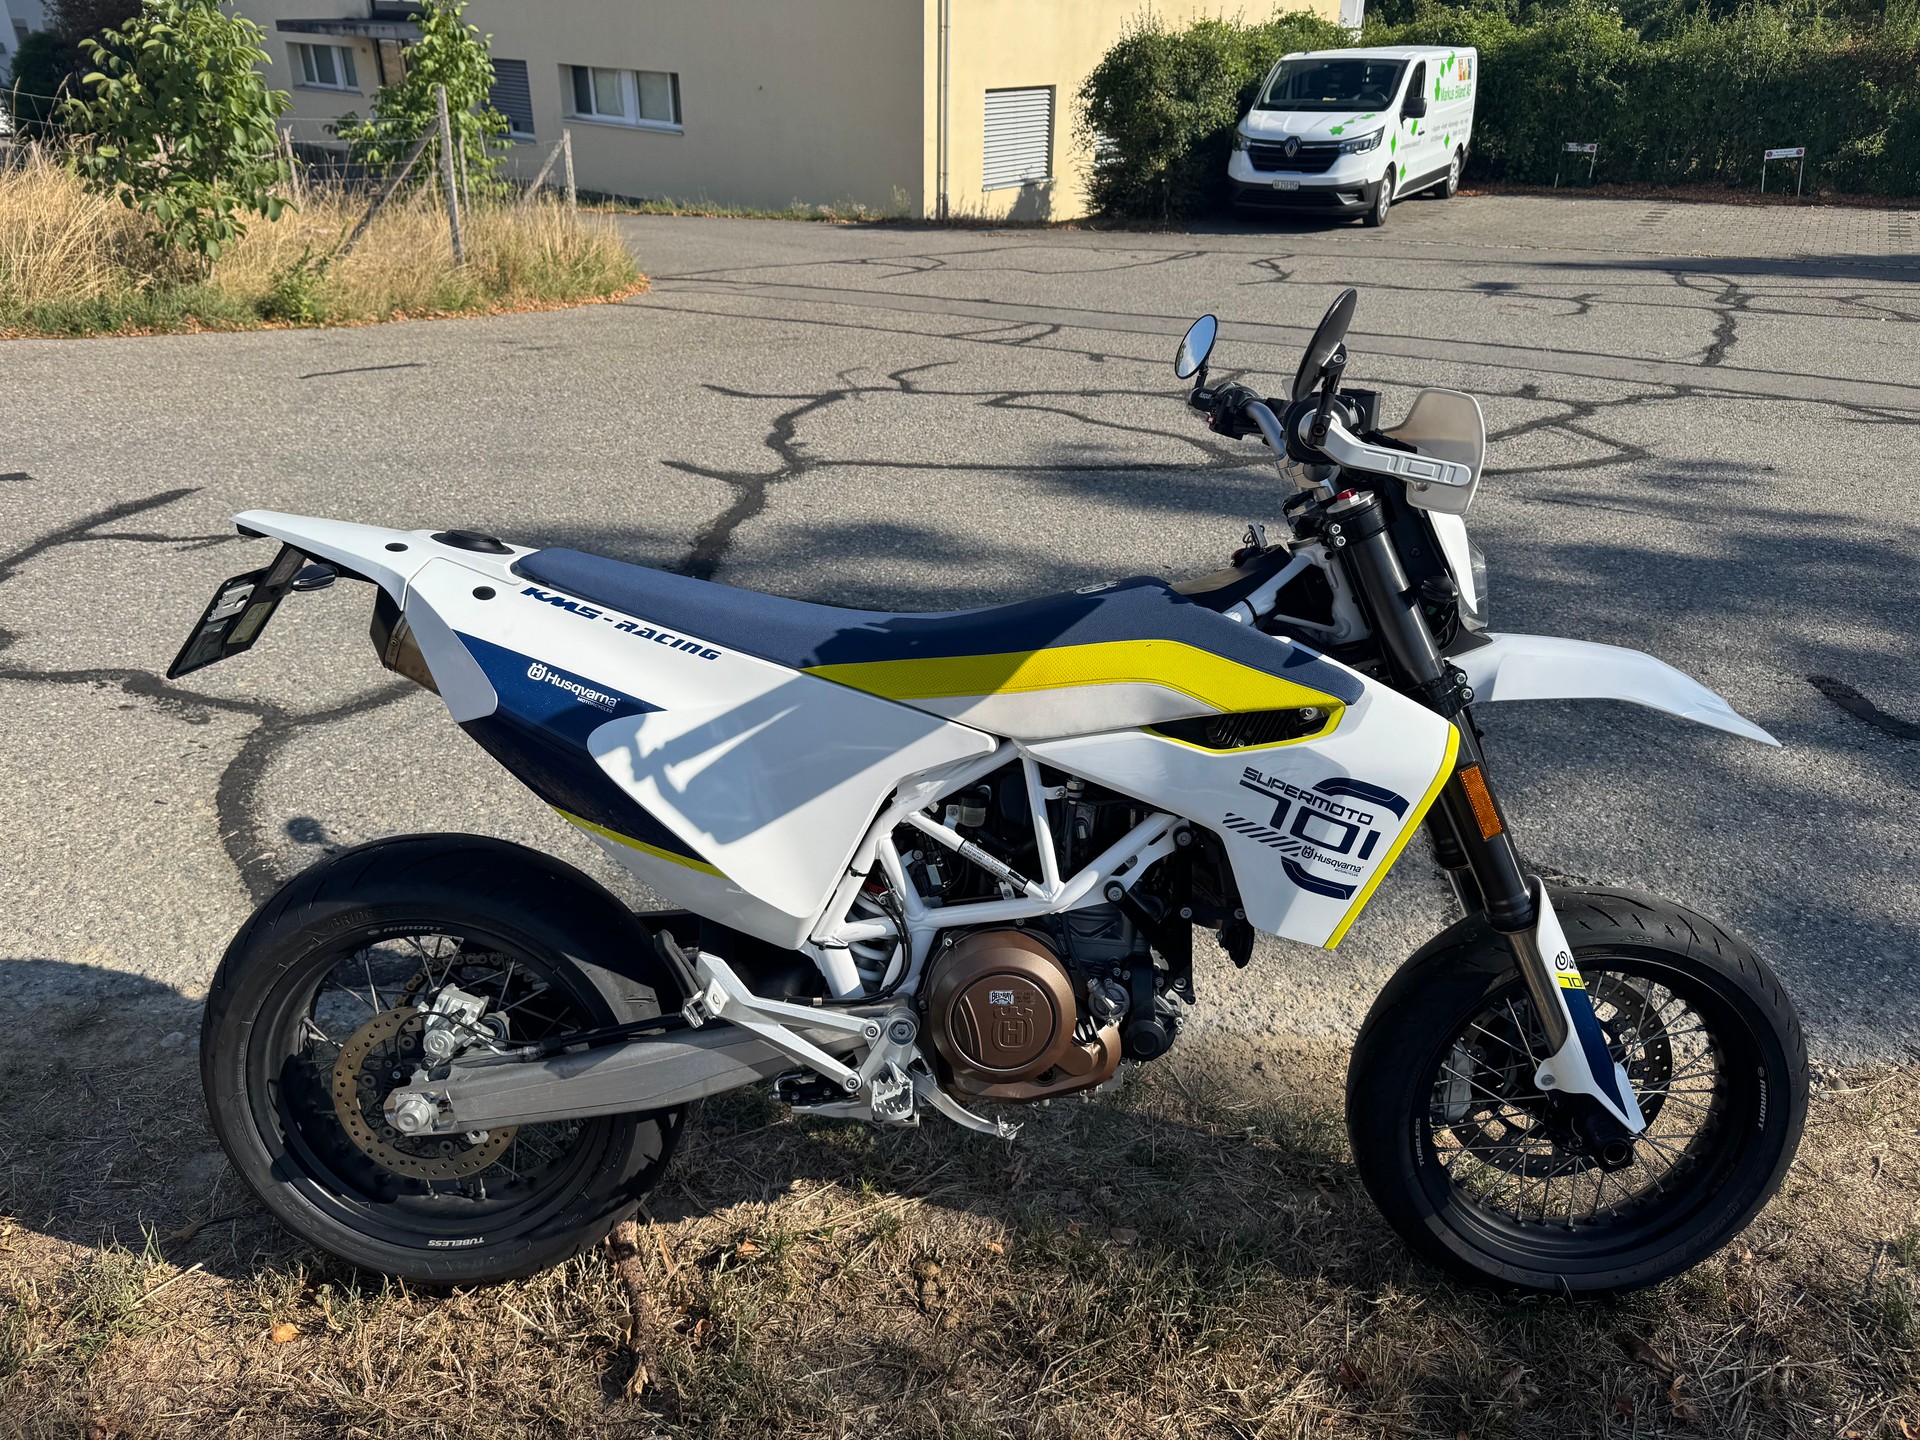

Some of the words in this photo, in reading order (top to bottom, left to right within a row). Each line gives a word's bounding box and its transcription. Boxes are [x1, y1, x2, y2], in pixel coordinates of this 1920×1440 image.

[1363, 449, 1457, 484] 701
[545, 671, 619, 708] Husqvarna
[576, 696, 613, 714] MOTORCYCLES
[1242, 766, 1374, 826] SUPERMOTO
[1239, 779, 1382, 861] 701
[1313, 852, 1362, 874] Husqvarna
[1415, 1117, 1425, 1167] TUBELESS
[427, 1236, 485, 1247] TUBELESS
